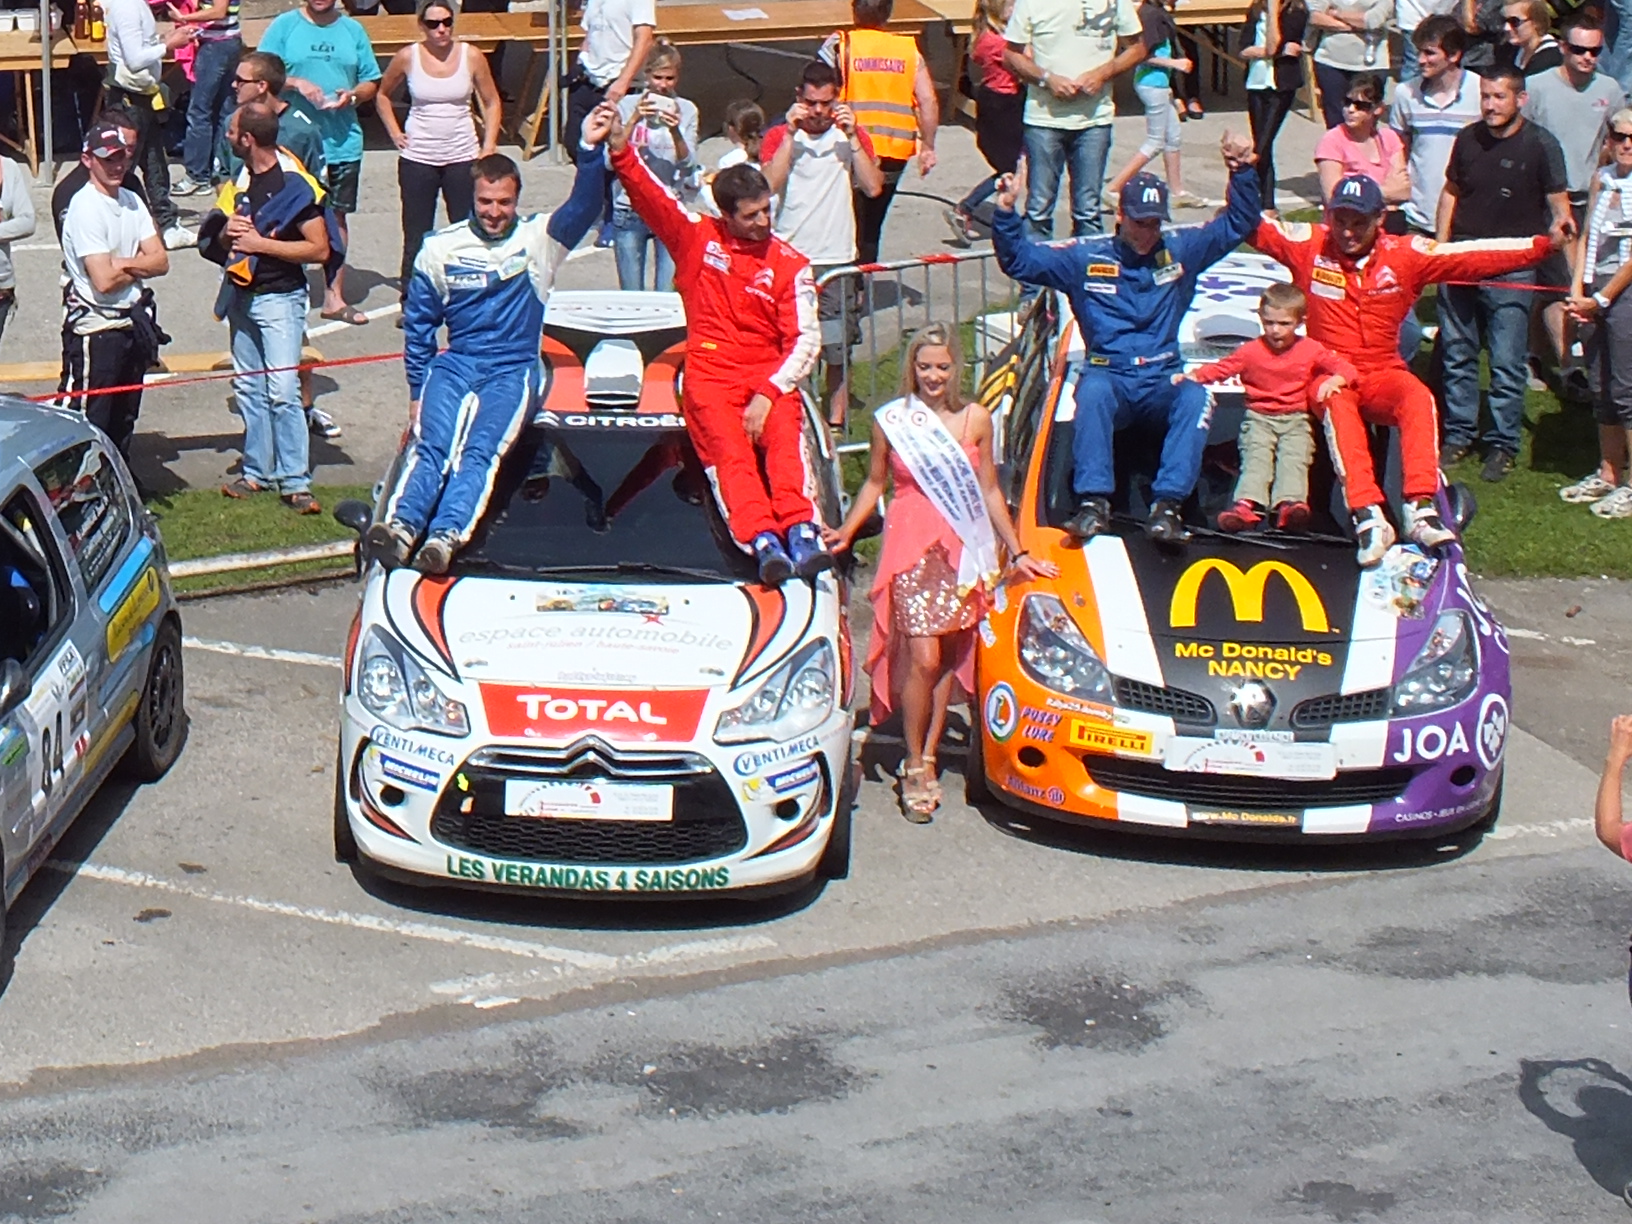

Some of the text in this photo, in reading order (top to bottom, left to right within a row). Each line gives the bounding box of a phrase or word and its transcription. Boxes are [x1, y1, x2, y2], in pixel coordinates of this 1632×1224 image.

[458, 624, 733, 652] espace automobile
[1174, 642, 1334, 667] Mc Donald's
[1207, 660, 1303, 682] NANCY
[515, 693, 668, 726] TOTAL
[41, 710, 66, 796] 84
[1077, 725, 1148, 752] PIRELLI
[1393, 720, 1470, 764] JOA
[446, 853, 731, 892] LES VERANDAS 4 SAISONS
